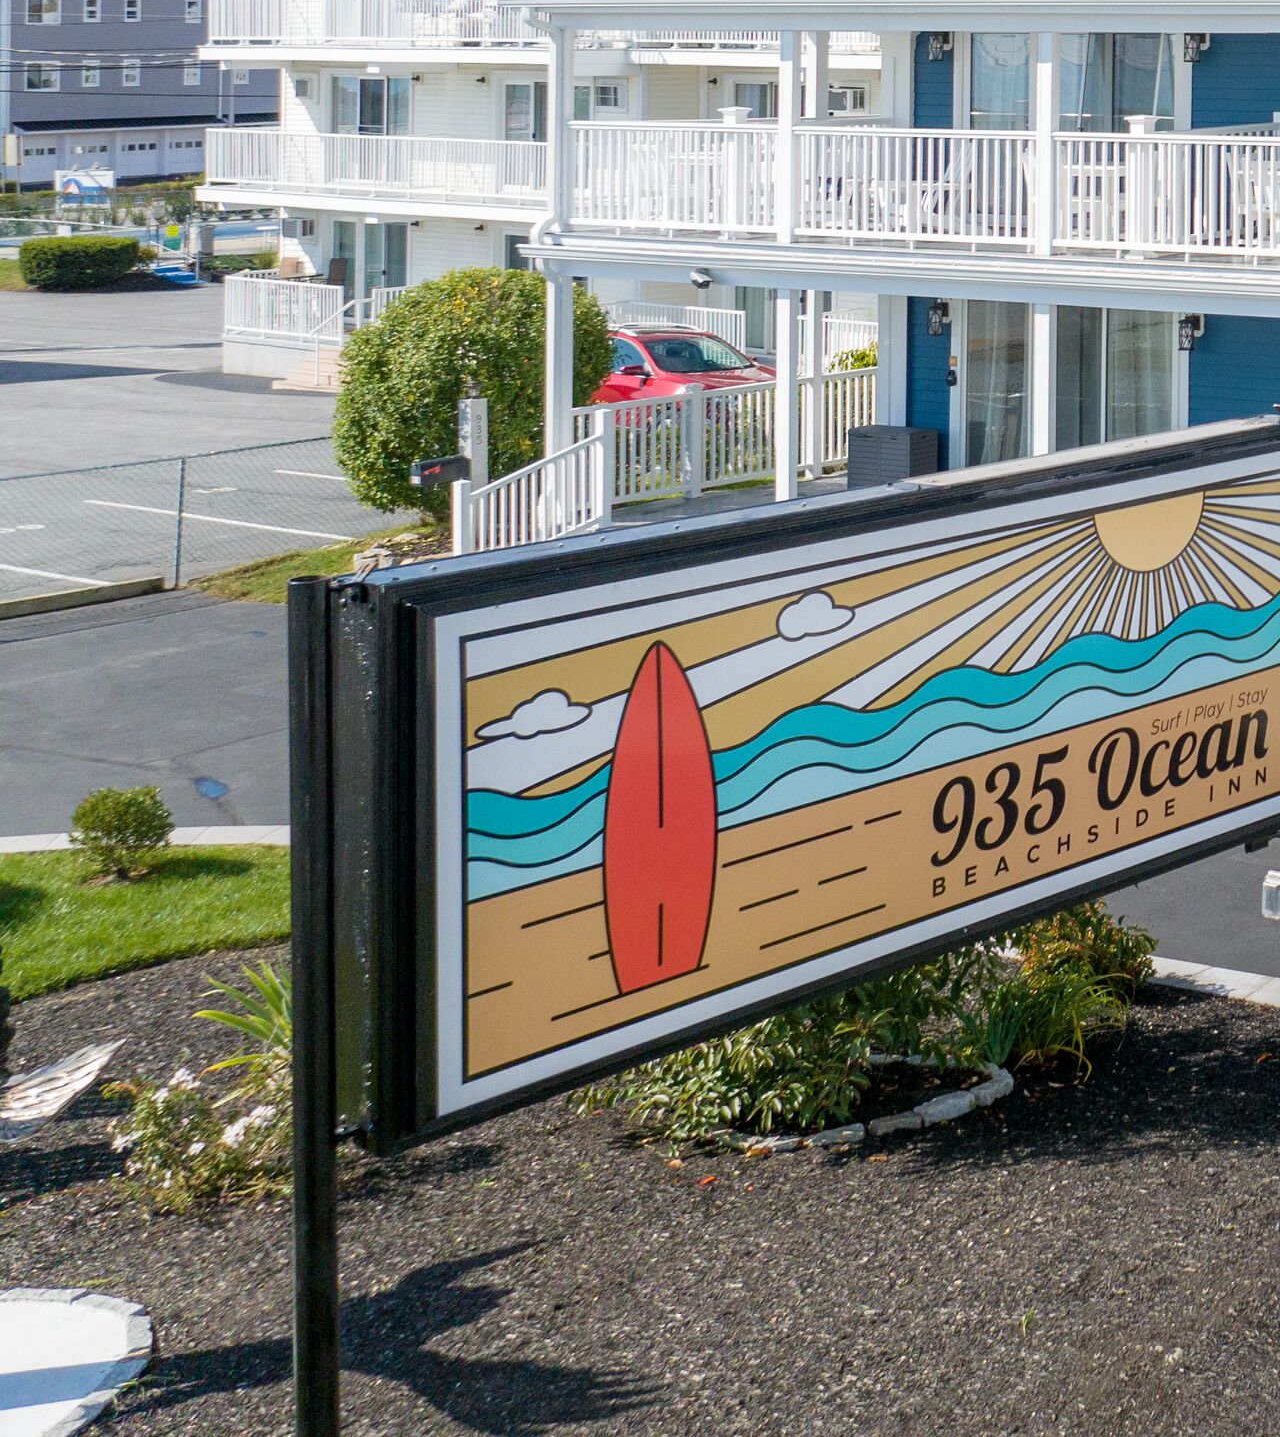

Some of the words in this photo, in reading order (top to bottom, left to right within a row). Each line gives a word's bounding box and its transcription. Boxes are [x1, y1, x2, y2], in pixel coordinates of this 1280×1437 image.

[1150, 711, 1182, 736] Surf
[1193, 701, 1225, 723] Play
[1237, 688, 1269, 709] Stay
[930, 743, 1069, 868] 935
[1088, 708, 1269, 812] Ocean
[931, 797, 1176, 899] BEACHSIDE
[1208, 765, 1268, 803] INN
